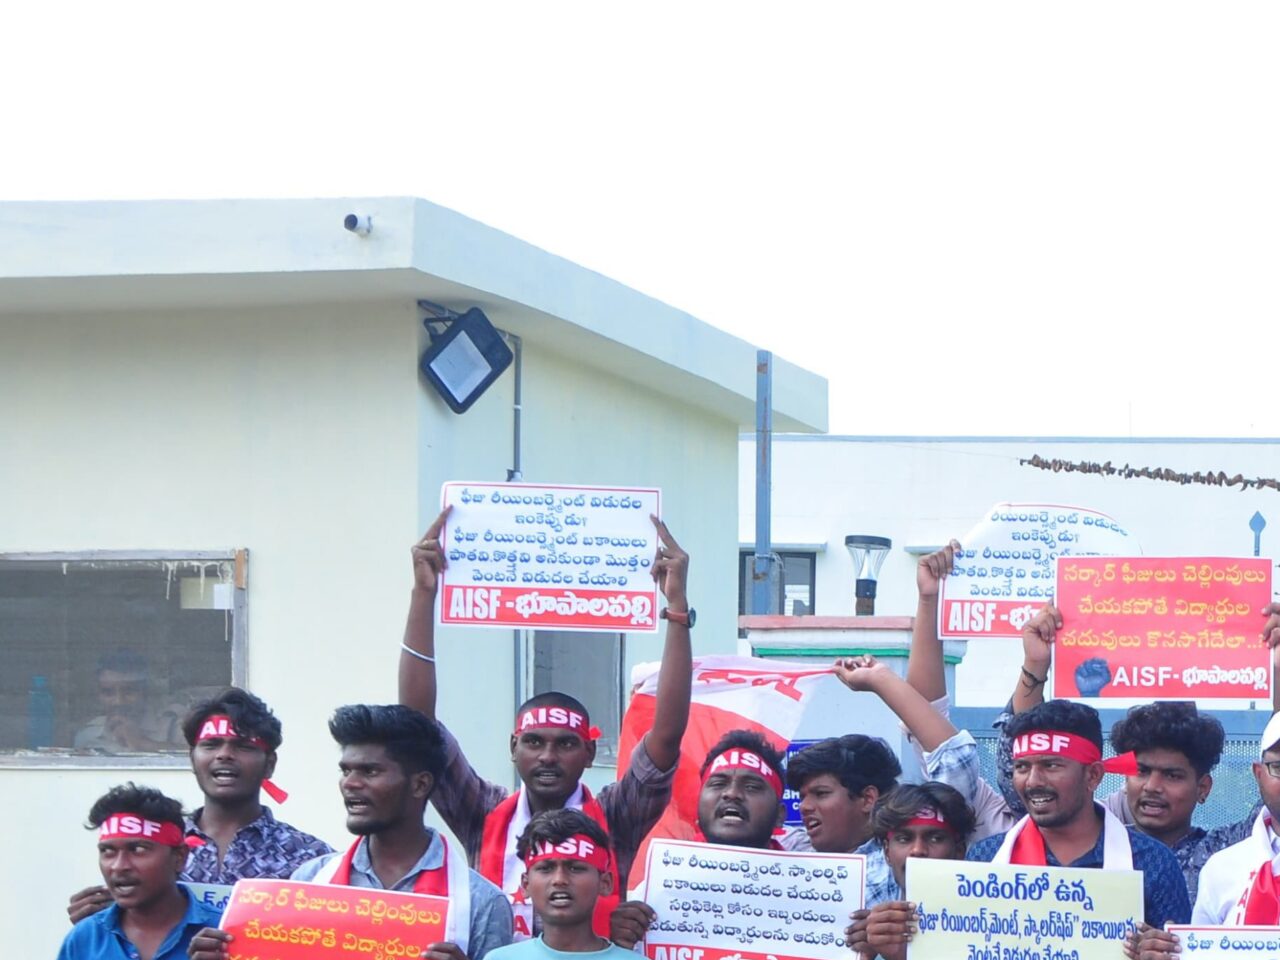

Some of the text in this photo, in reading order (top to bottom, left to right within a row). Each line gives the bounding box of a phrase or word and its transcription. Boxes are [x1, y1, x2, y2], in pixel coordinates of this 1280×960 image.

[590, 496, 642, 509] విడుదల
[582, 537, 647, 548] బకాయిలు
[522, 571, 573, 584] విడుదల
[578, 571, 628, 587] చేయాలి
[450, 588, 501, 619] AISF
[949, 602, 996, 631] AISF
[520, 706, 584, 731] AISF
[710, 750, 774, 778] AISF
[663, 879, 843, 902] బకాయిలు విడుదల చేయండి
[1054, 879, 1093, 911] ఉన్న
[727, 902, 763, 917] కోసం
